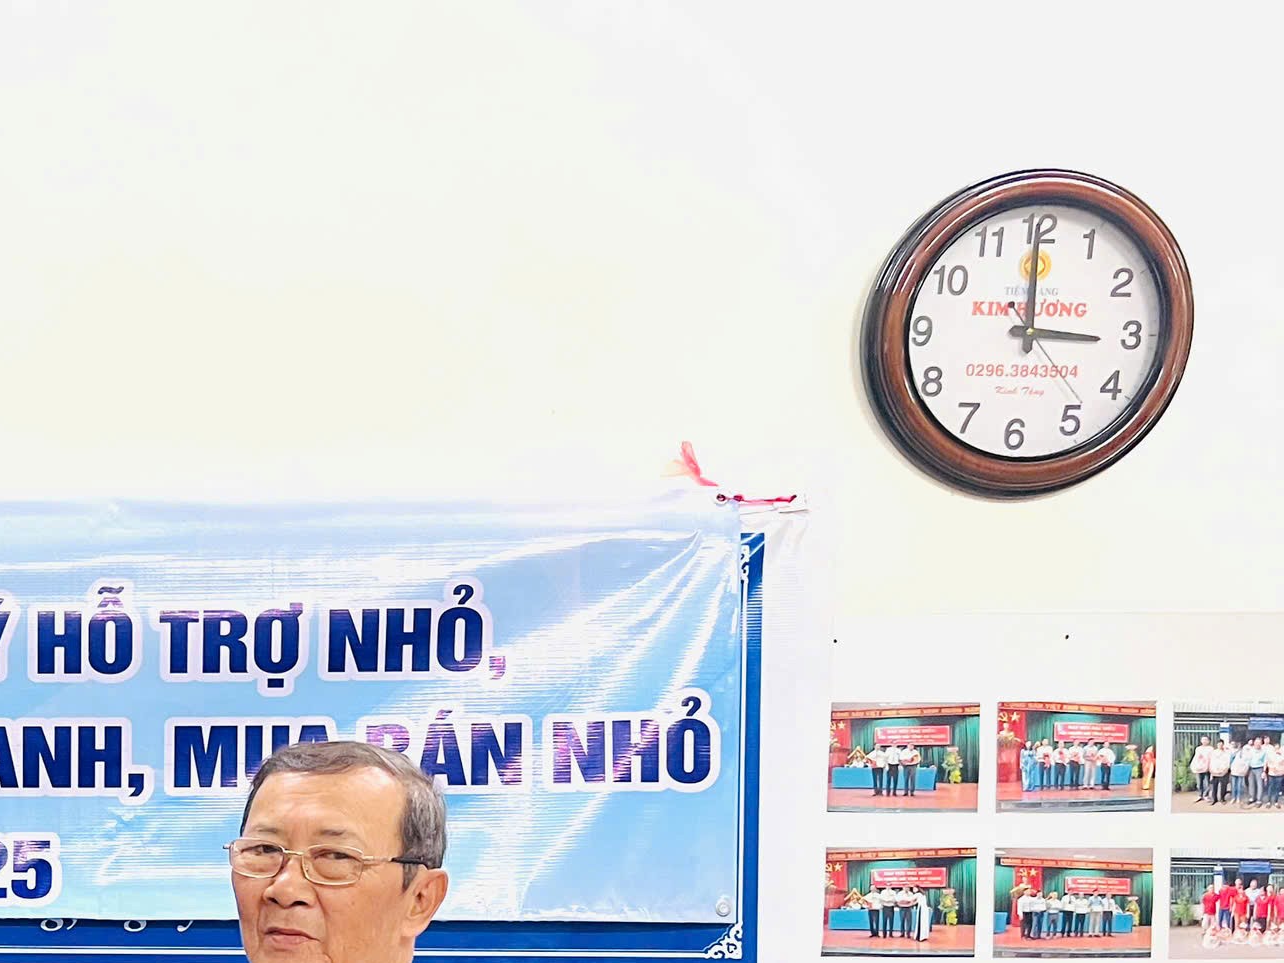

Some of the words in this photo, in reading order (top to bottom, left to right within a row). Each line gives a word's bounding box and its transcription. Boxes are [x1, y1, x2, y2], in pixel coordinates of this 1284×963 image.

[975, 226, 1005, 257] 11
[1022, 213, 1057, 244] 12
[1082, 229, 1096, 260] 1
[933, 265, 968, 296] 10
[1110, 267, 1135, 298] 2
[972, 301, 1009, 316] KIM
[911, 316, 933, 347] 9
[1120, 320, 1142, 350] 3
[921, 366, 943, 397] 8
[966, 363, 1079, 378] 0296.3843504
[1099, 370, 1123, 400] 4
[958, 402, 980, 434] 7
[1059, 404, 1082, 436] 5
[1003, 418, 1026, 450] 6
[37, 587, 133, 675] HỖ
[160, 603, 303, 689] TRỢ
[327, 585, 507, 681] NHỎ,
[553, 695, 711, 785] NHỎ
